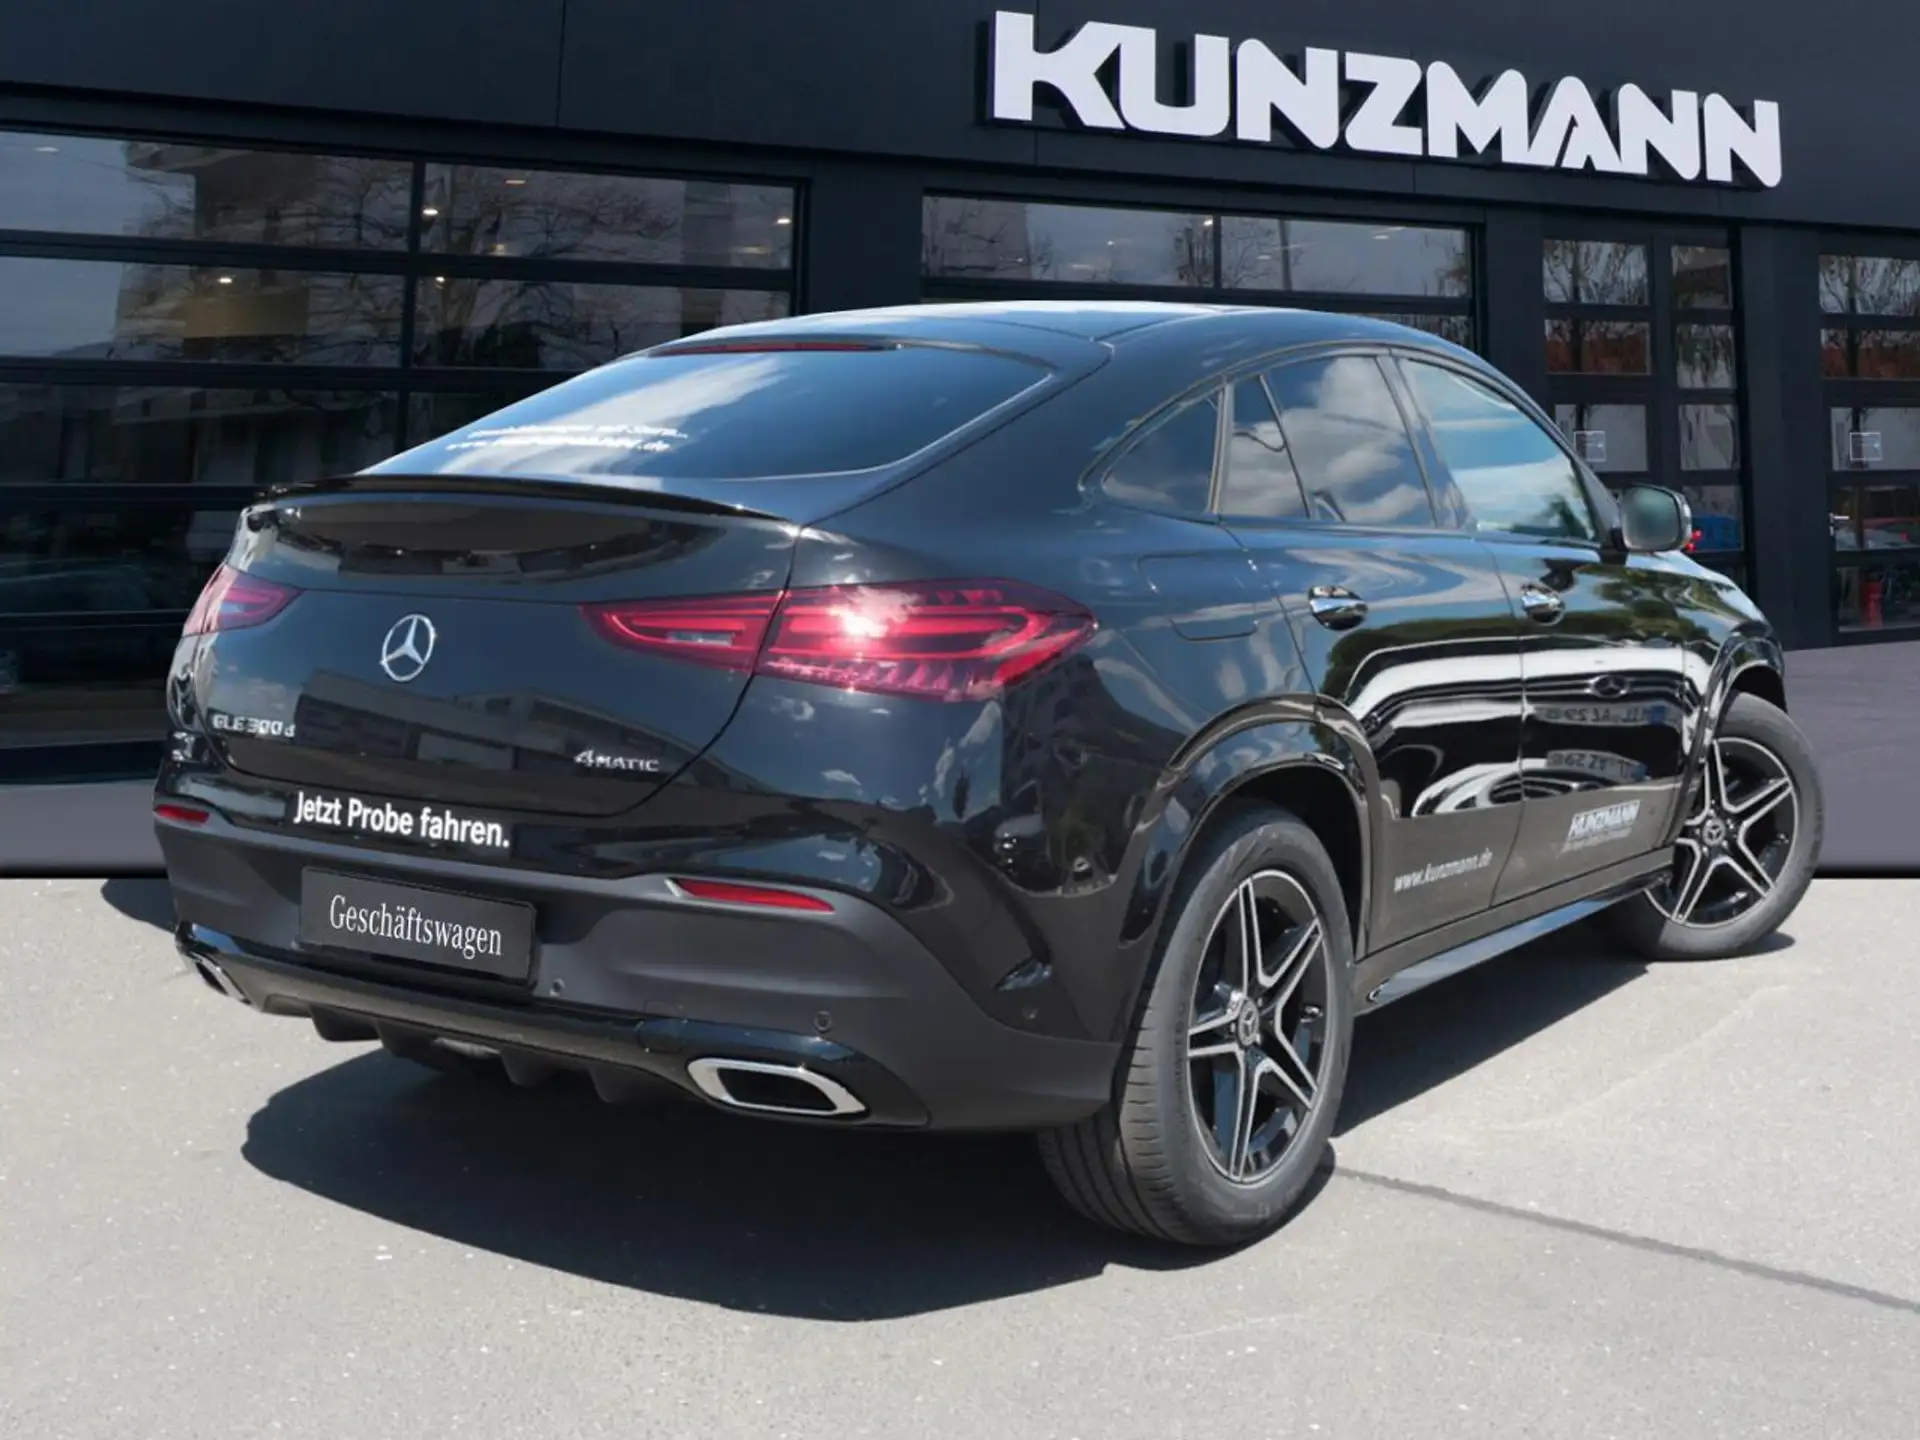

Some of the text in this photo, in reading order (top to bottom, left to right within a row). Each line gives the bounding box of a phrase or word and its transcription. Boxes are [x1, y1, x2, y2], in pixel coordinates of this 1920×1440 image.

[993, 10, 1783, 189] KUNZMANN
[211, 714, 297, 738] GLE 300 d
[573, 748, 661, 773] 4MATIC
[293, 791, 510, 849] Jetzt Probe fahren.
[329, 893, 503, 960] Geschäftswagen
